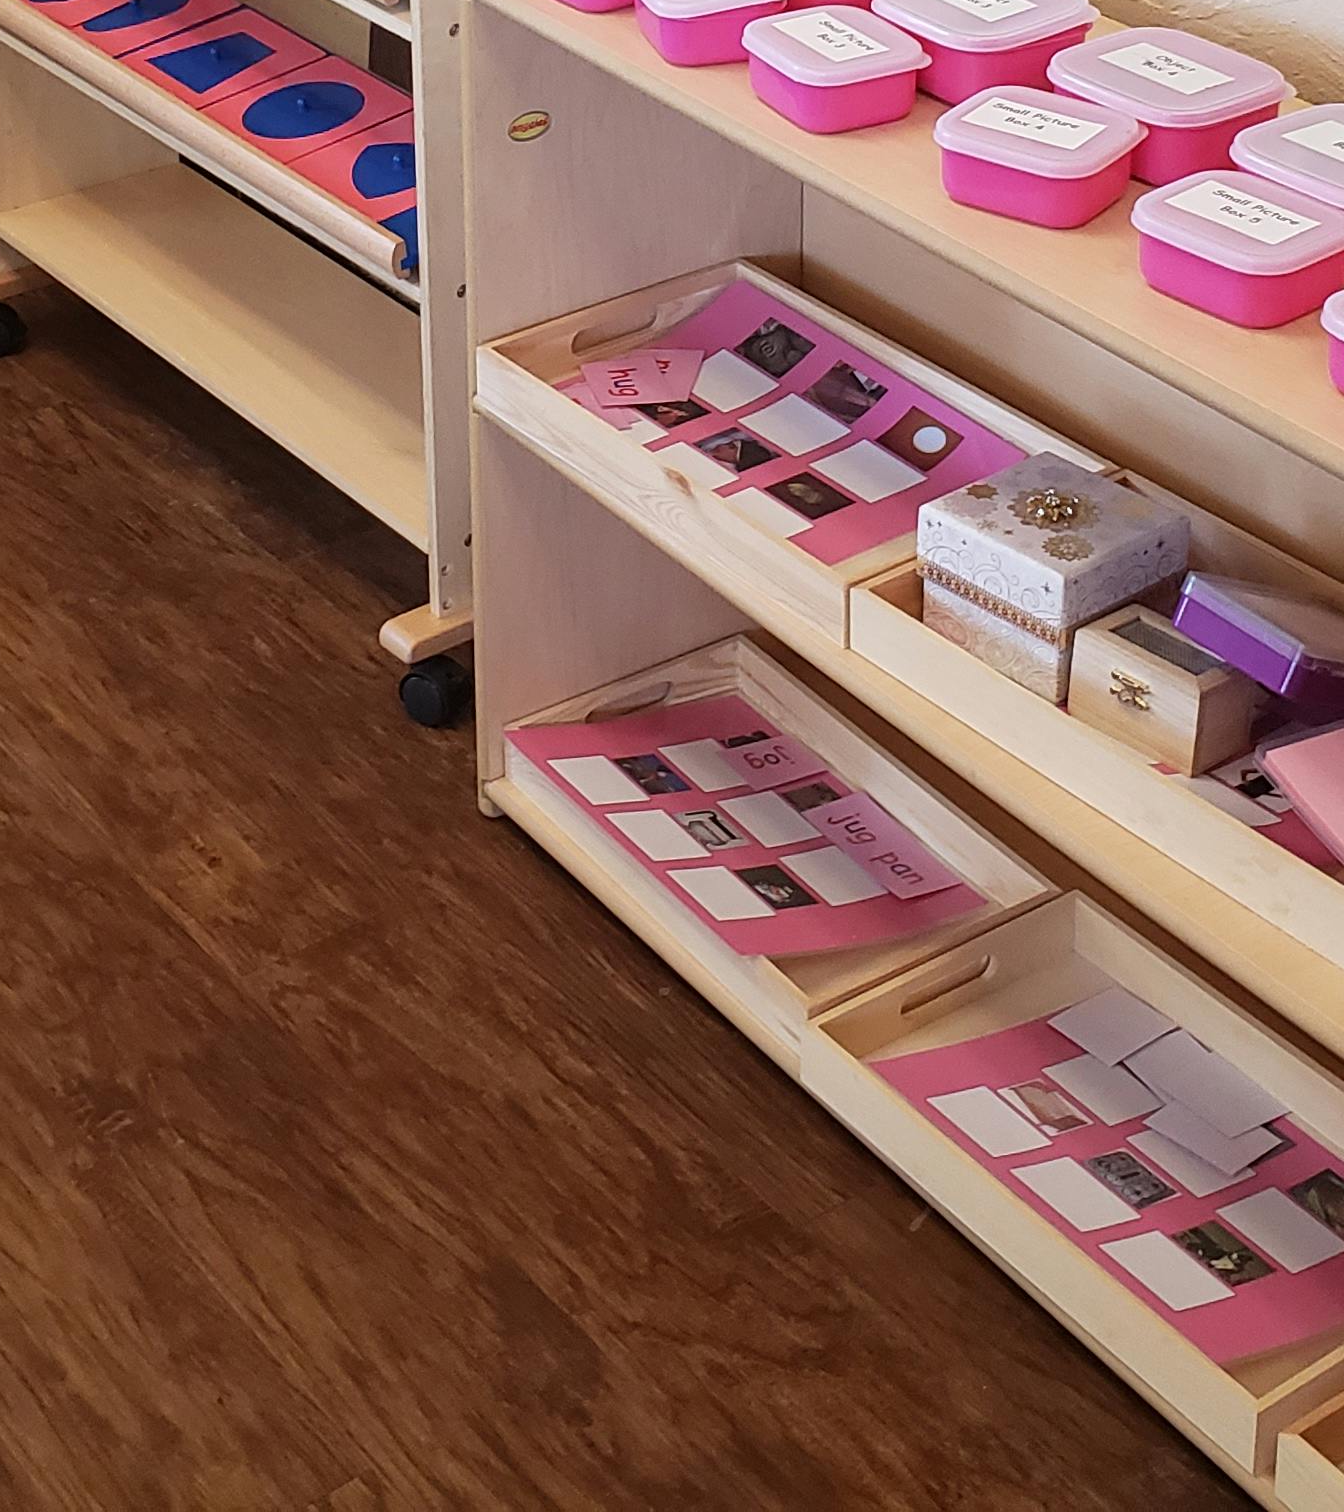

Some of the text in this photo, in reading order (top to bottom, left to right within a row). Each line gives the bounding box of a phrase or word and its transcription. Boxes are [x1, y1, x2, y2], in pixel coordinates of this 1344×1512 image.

[816, 33, 836, 44] Box
[818, 20, 874, 50] Small Picture
[1141, 60, 1164, 72] Box
[1156, 54, 1196, 72] Object
[993, 102, 1081, 130] Small Picture
[1004, 116, 1046, 132] Box 4
[1212, 188, 1301, 227] Small Picture
[1219, 205, 1262, 225] Box 5
[607, 367, 639, 397] hug
[742, 744, 796, 770] jog
[827, 812, 924, 886] jug pan
